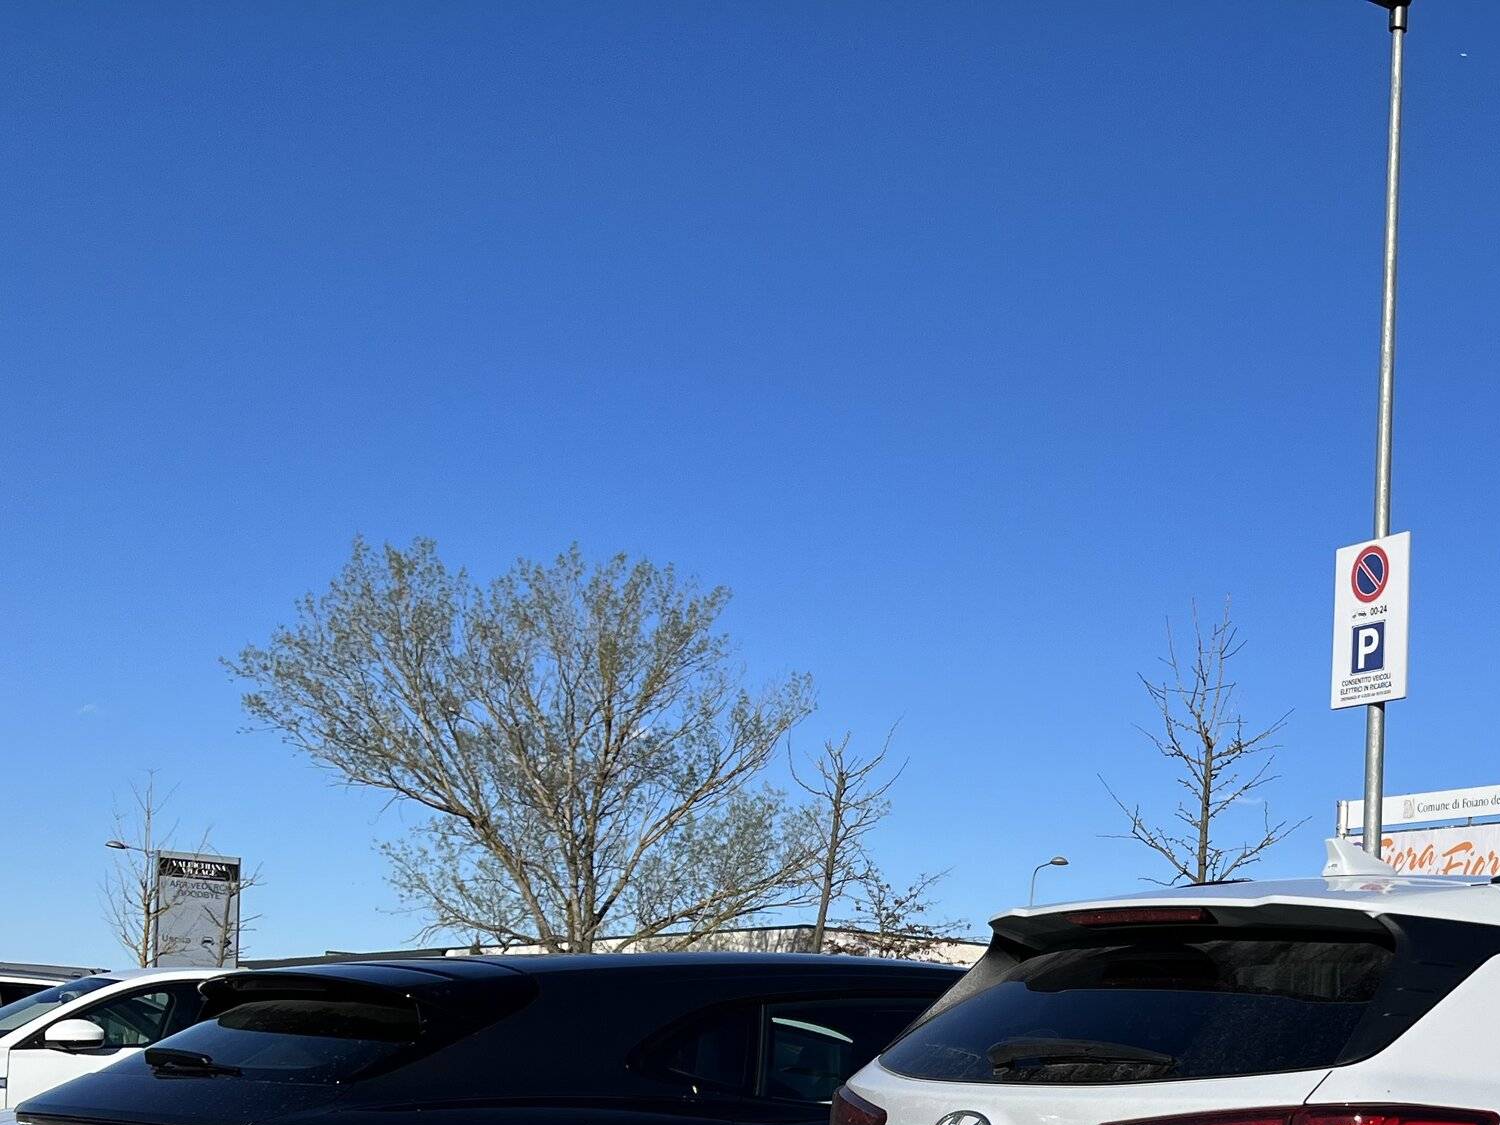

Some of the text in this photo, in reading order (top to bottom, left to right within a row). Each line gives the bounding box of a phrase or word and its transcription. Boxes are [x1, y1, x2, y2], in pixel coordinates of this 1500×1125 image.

[1370, 605, 1387, 615] 00-24
[1357, 628, 1379, 669] P
[1342, 673, 1391, 687] CONSENTITO VEICOLI
[1340, 686, 1362, 695] ELETTRICI
[1370, 681, 1392, 690] RICARICA
[1417, 802, 1449, 813] Comune
[1452, 799, 1459, 809] di
[1462, 798, 1489, 808] Foiano
